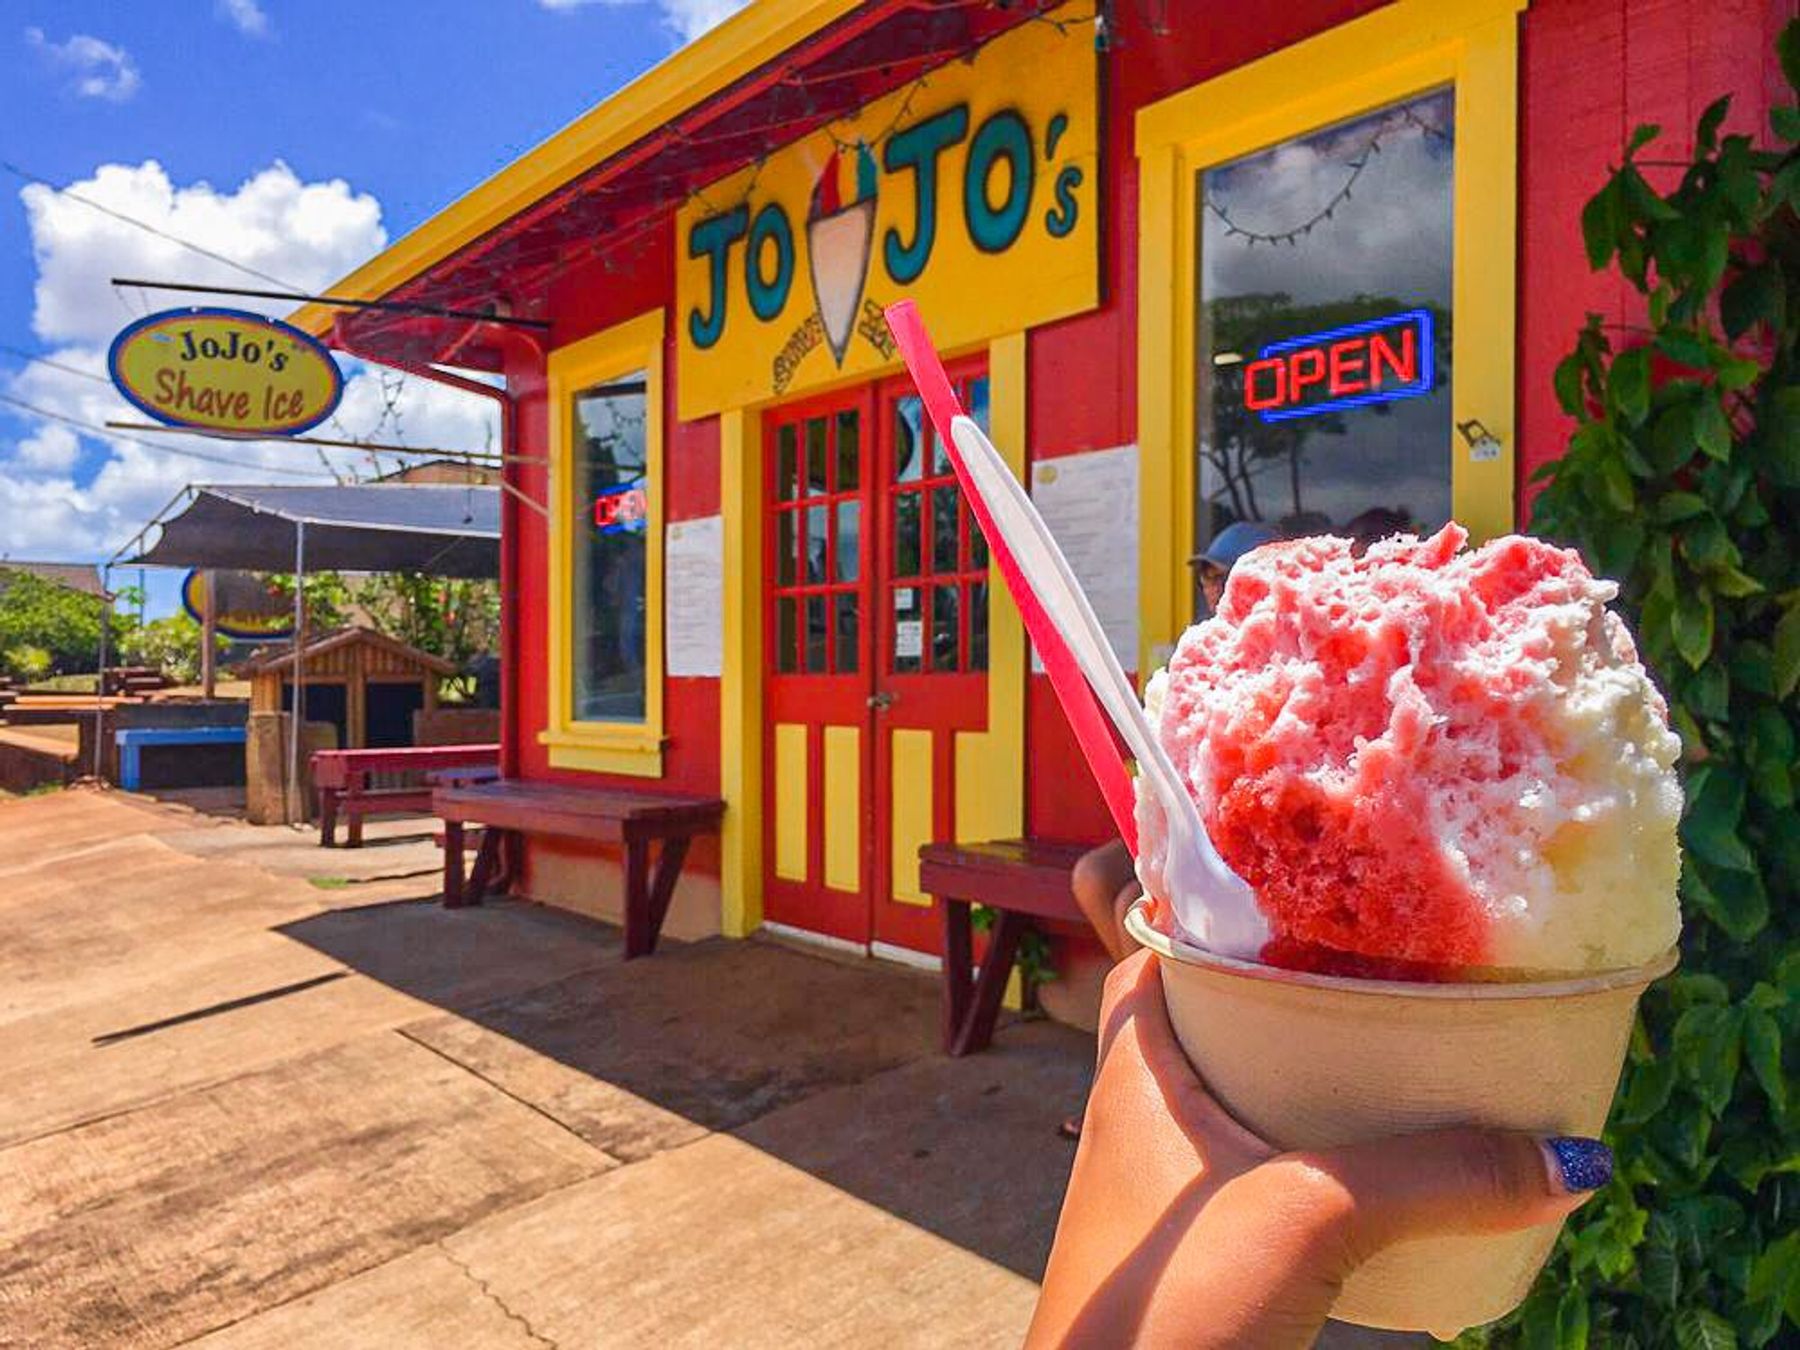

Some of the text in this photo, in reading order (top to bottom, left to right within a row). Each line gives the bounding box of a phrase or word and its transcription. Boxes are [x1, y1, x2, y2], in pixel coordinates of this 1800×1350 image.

[179, 330, 289, 372] JoJo's
[1243, 317, 1414, 411] OPEN
[155, 367, 304, 420] Shave Ice
